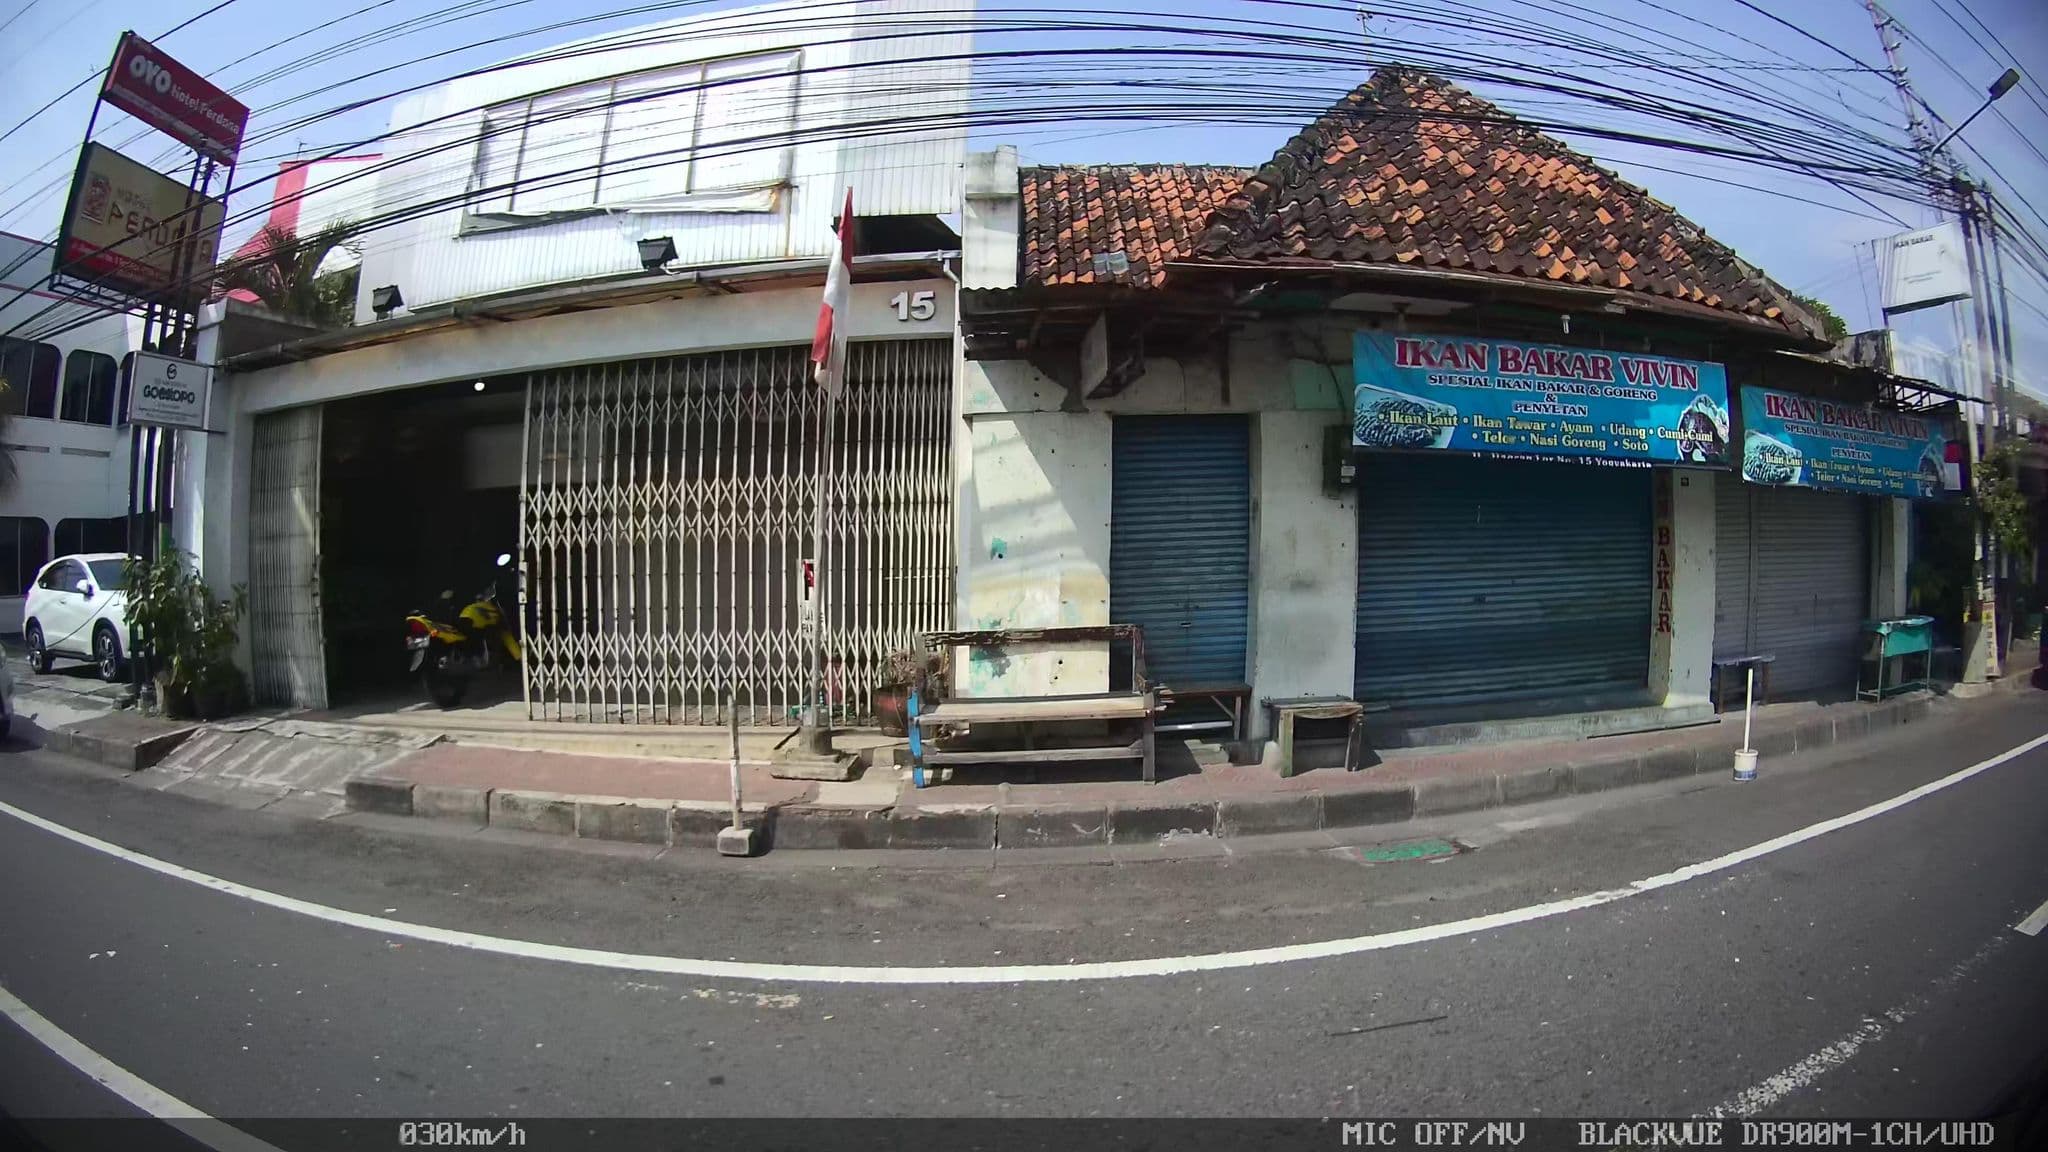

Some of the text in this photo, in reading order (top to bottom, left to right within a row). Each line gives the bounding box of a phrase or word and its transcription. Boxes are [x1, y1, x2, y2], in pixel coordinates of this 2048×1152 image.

[129, 54, 171, 94] OYO
[890, 290, 936, 321] 15
[1396, 338, 1699, 391] IKAN BAKAR VIVIN
[1428, 374, 1658, 401] SPESIAL IKAN BAKAR & GORENG
[1545, 393, 1557, 403] &
[1389, 410, 1421, 424] Ikan
[1426, 412, 1458, 427] Laut
[1473, 415, 1503, 429] Ikan
[1507, 416, 1547, 431] Tawar
[1559, 420, 1593, 435] Ayam
[1610, 423, 1646, 439] Udang
[1513, 402, 1588, 417] PENYETAN
[1764, 392, 1817, 424] IKAN
[1822, 402, 1885, 434] BAKAR
[1530, 434, 1558, 447] Nasi
[1562, 435, 1606, 450] Goreng
[1622, 439, 1649, 452] Soto
[1656, 527, 1671, 633] BAKAR
